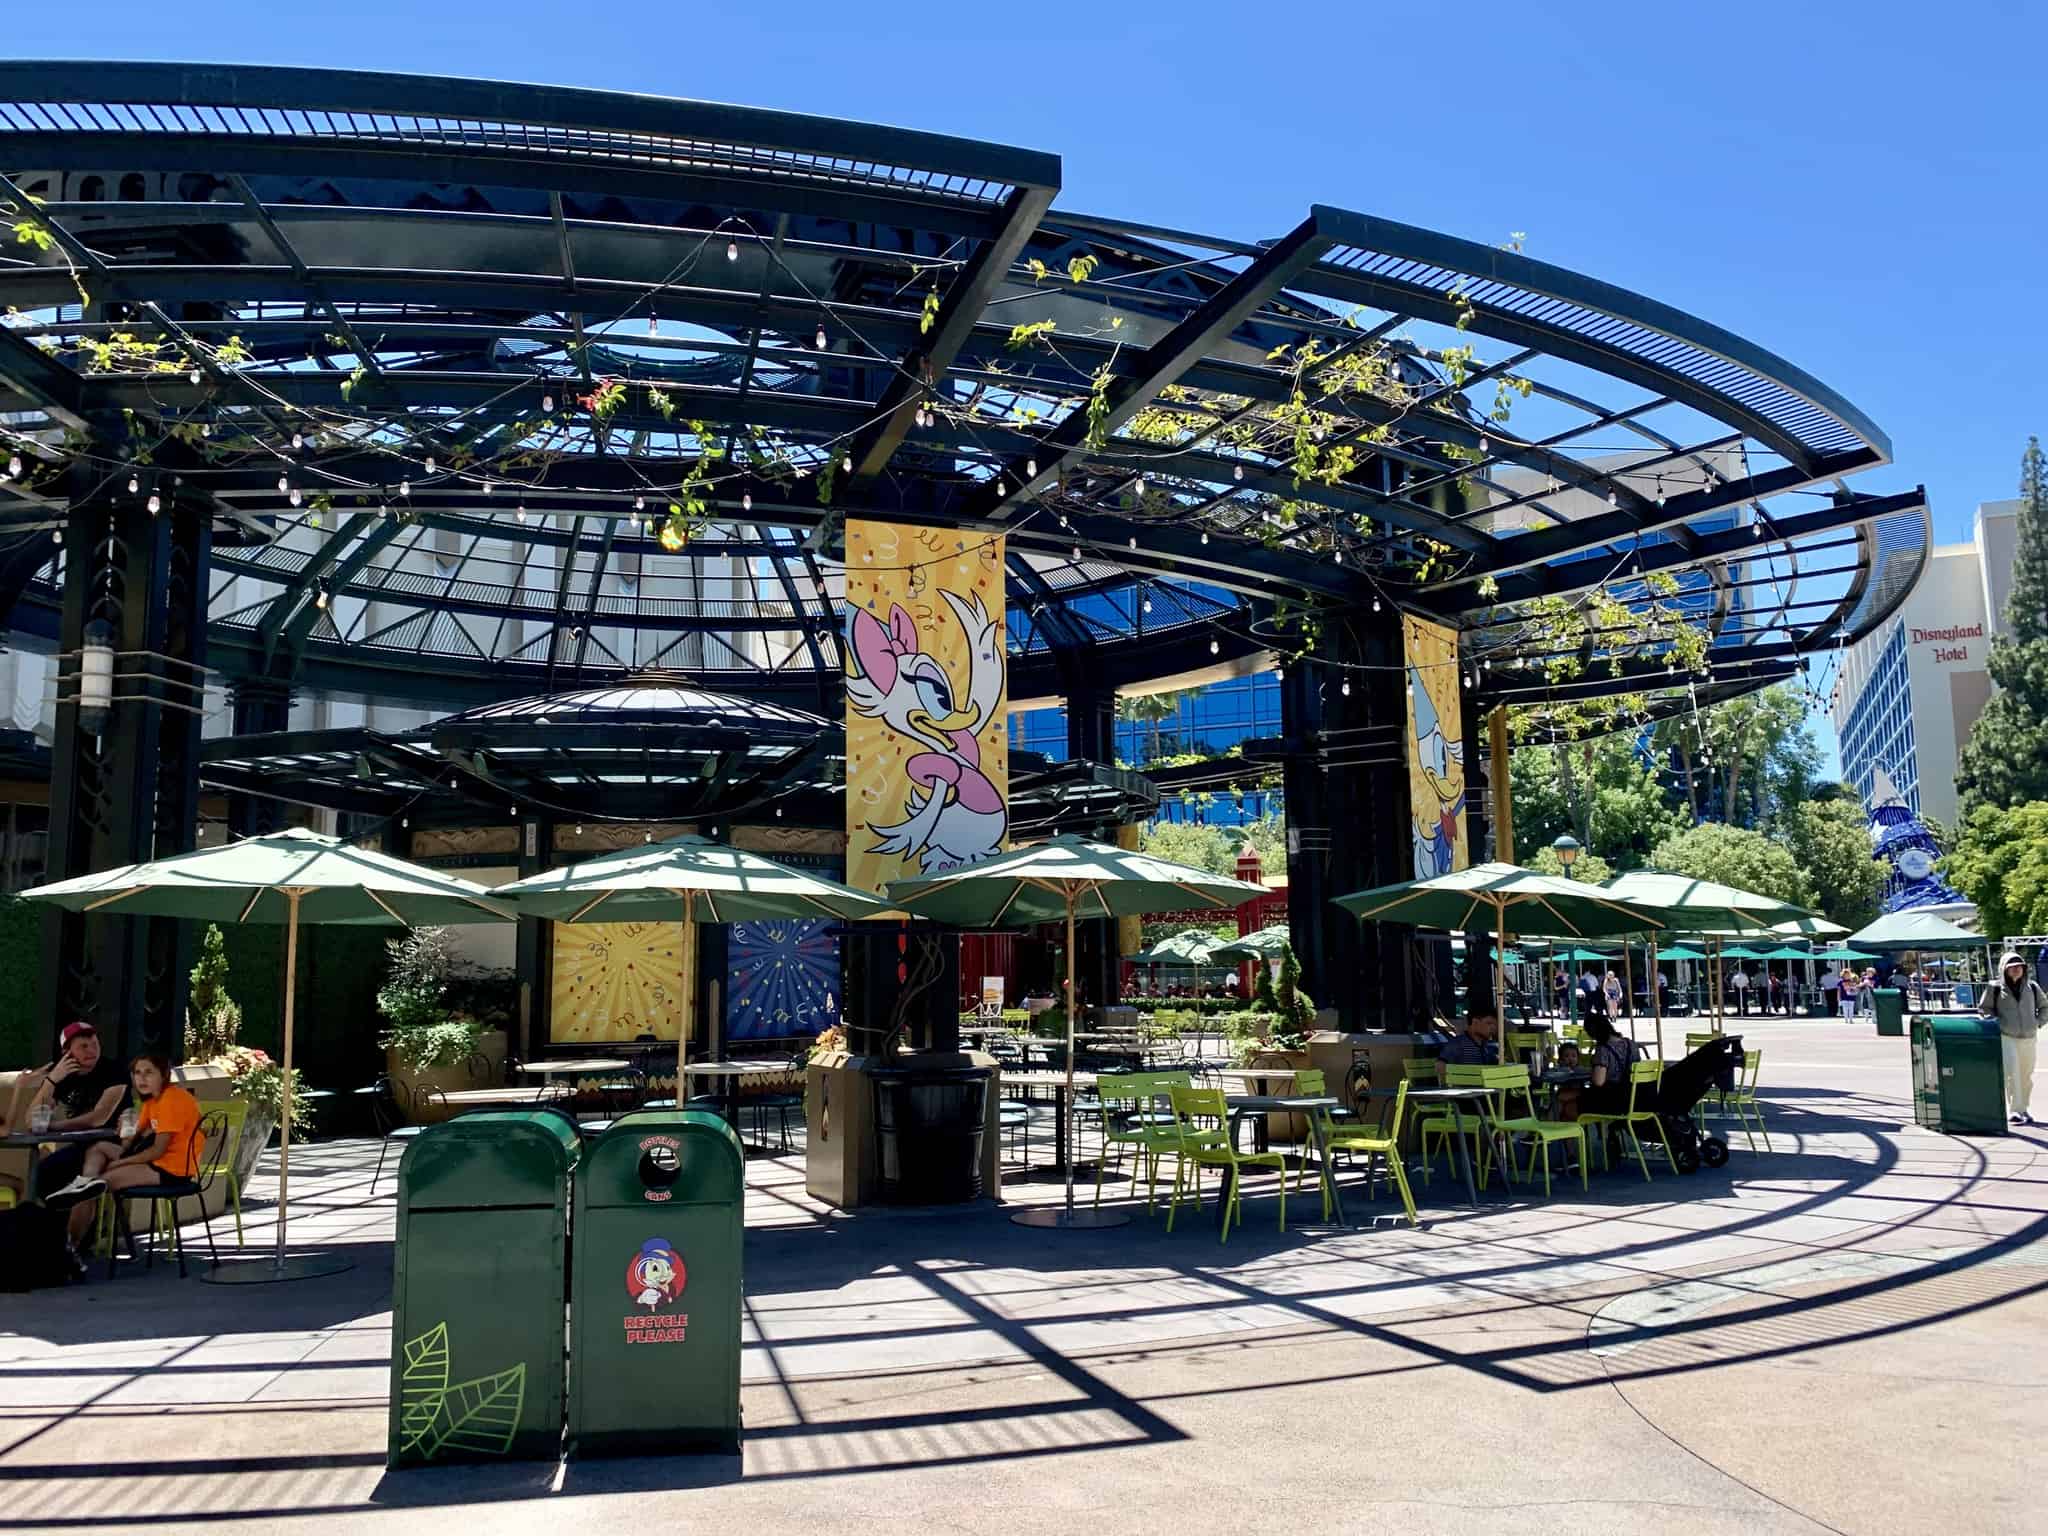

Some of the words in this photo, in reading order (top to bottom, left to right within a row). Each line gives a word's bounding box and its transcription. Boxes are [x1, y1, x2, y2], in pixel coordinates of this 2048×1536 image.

[1910, 623, 1983, 644] Disneyland
[1932, 646, 1968, 664] Hotel
[624, 1314, 688, 1329] RECYCLE
[627, 1328, 686, 1344] PLEASE
